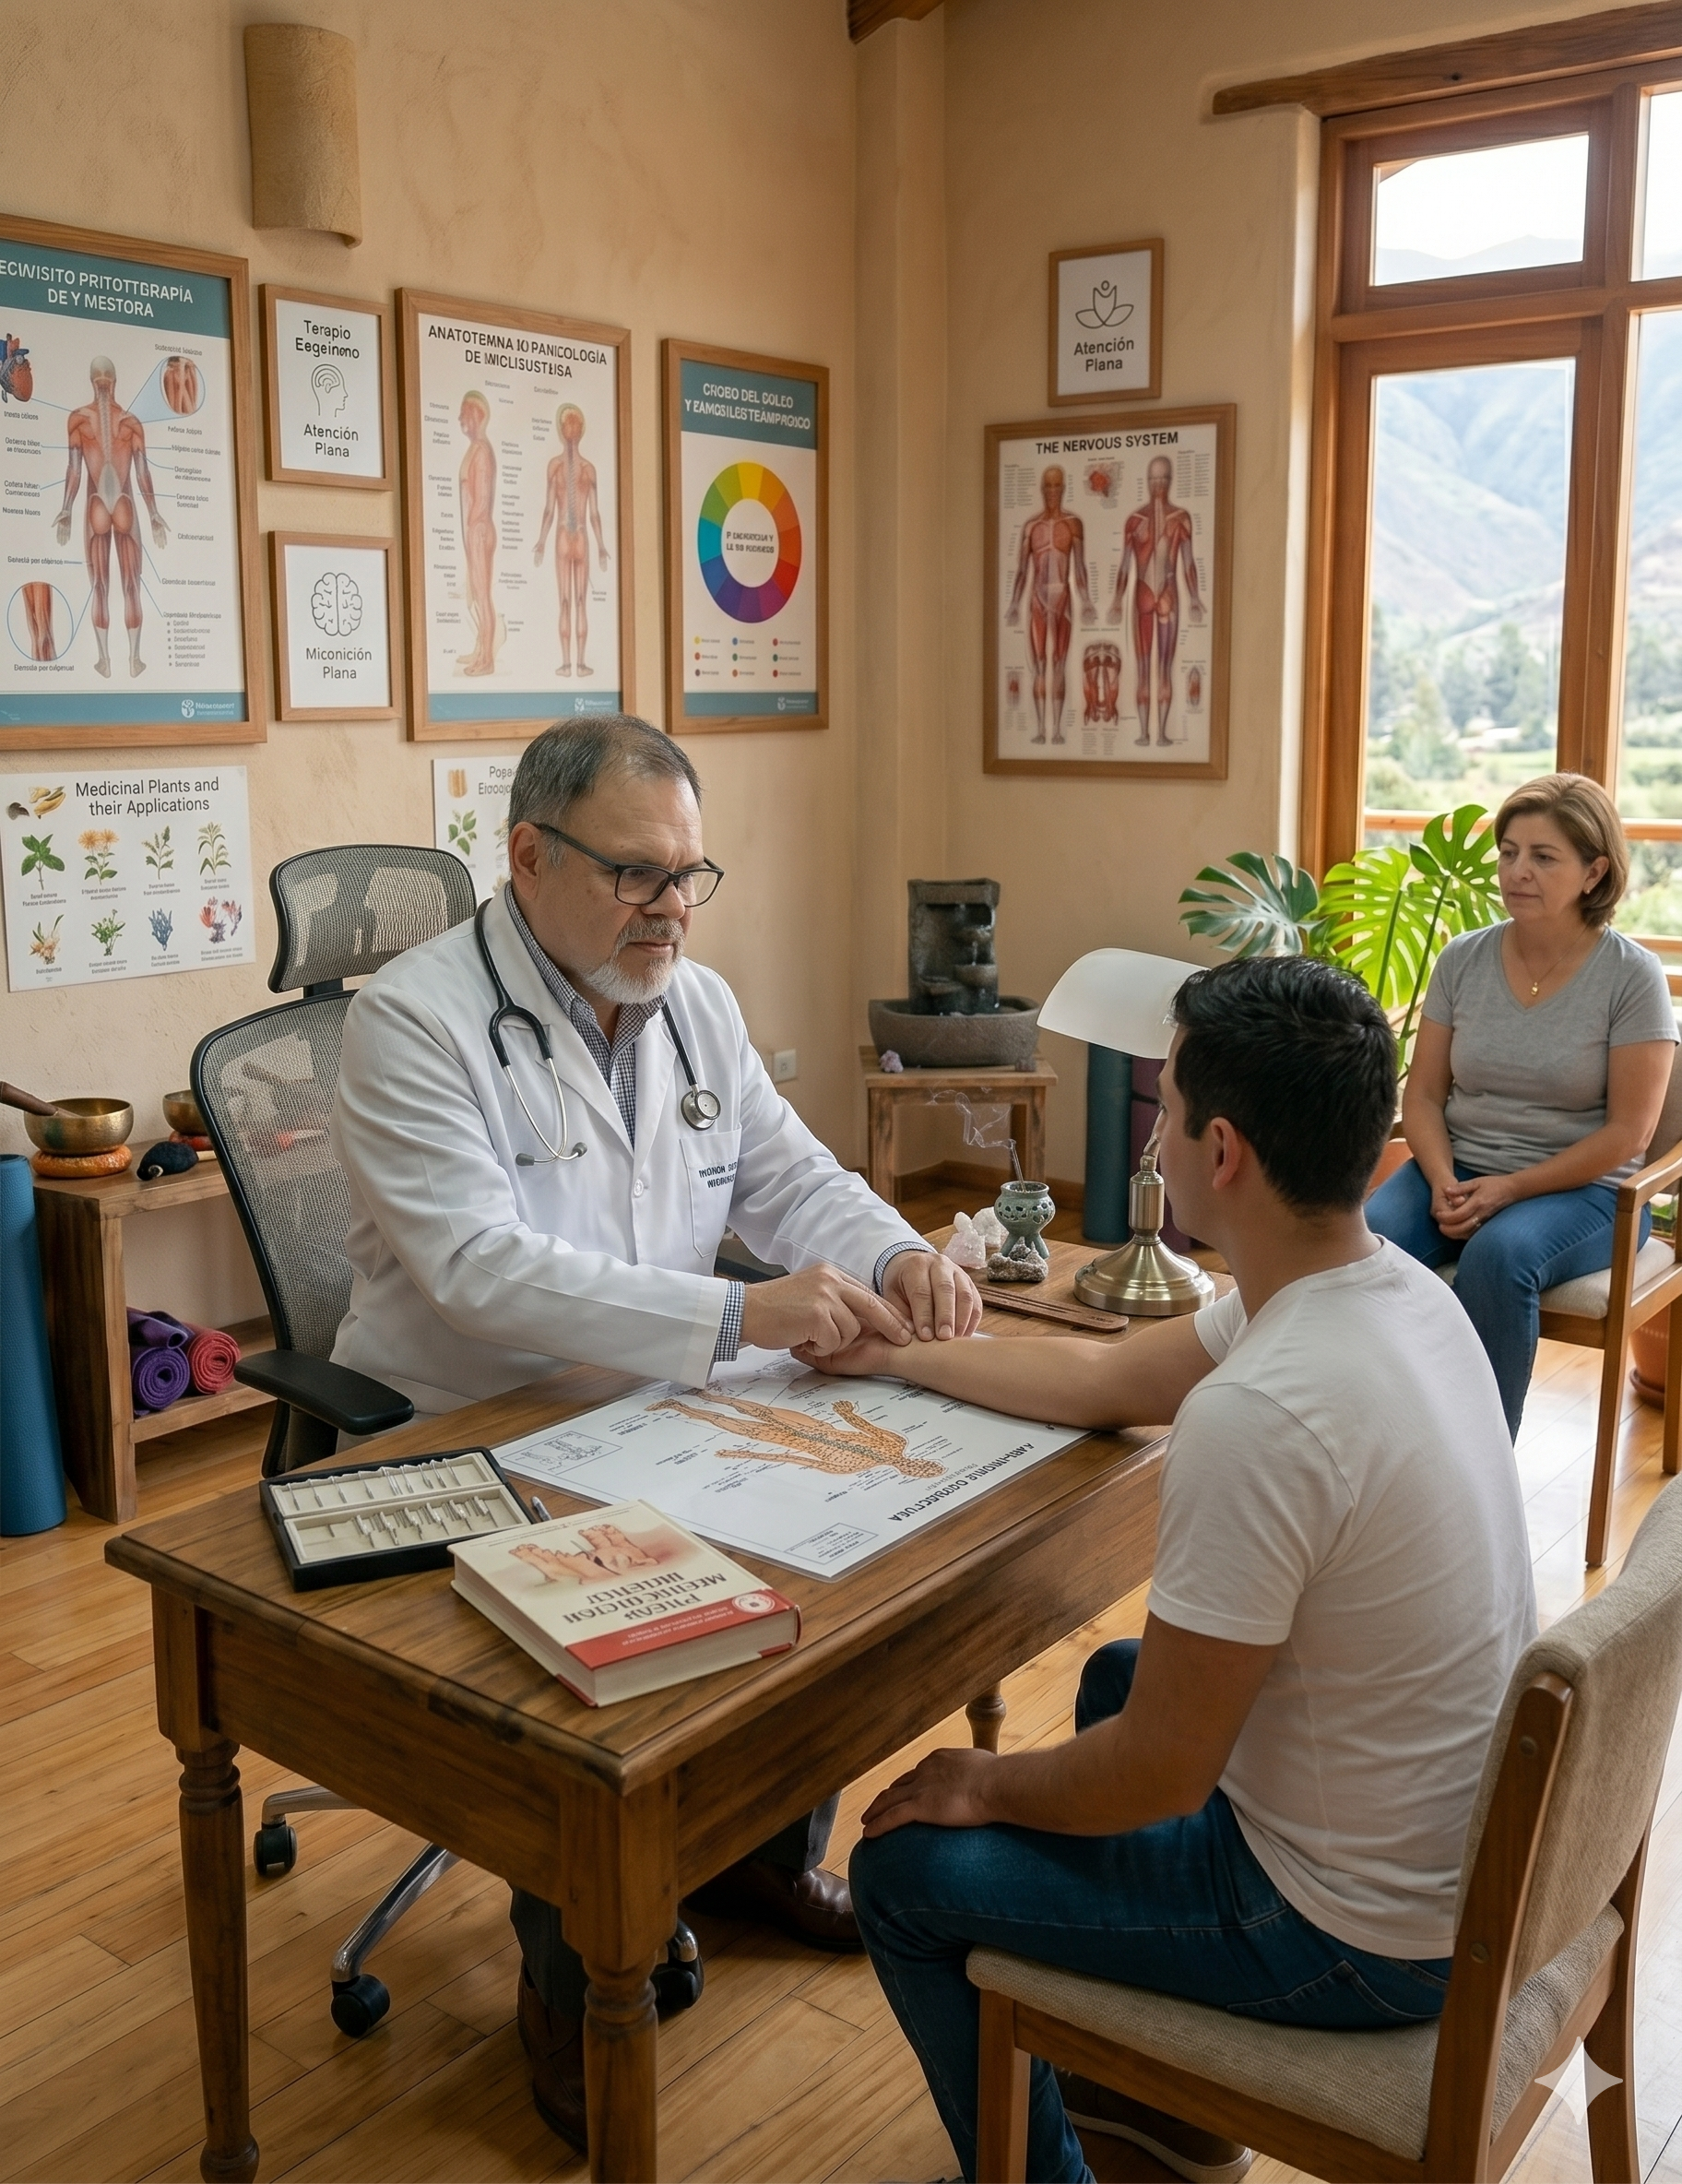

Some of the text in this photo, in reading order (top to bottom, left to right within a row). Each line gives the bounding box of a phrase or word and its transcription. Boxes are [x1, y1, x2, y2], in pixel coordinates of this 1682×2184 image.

[48, 288, 154, 318] DE Y MESTORA
[303, 319, 351, 341] Terapio
[1073, 336, 1134, 356] Atención
[465, 349, 481, 364] DE
[684, 398, 693, 412] Y
[740, 388, 761, 404] DEL
[303, 423, 359, 442] Atención
[315, 442, 349, 457] Plana
[1036, 431, 1179, 455] THE NERVOUS SYSTEM
[306, 647, 373, 661] Miconición
[323, 666, 358, 680] Plana
[76, 776, 220, 798] Medicinal Plants and
[89, 798, 210, 818] their Applications
